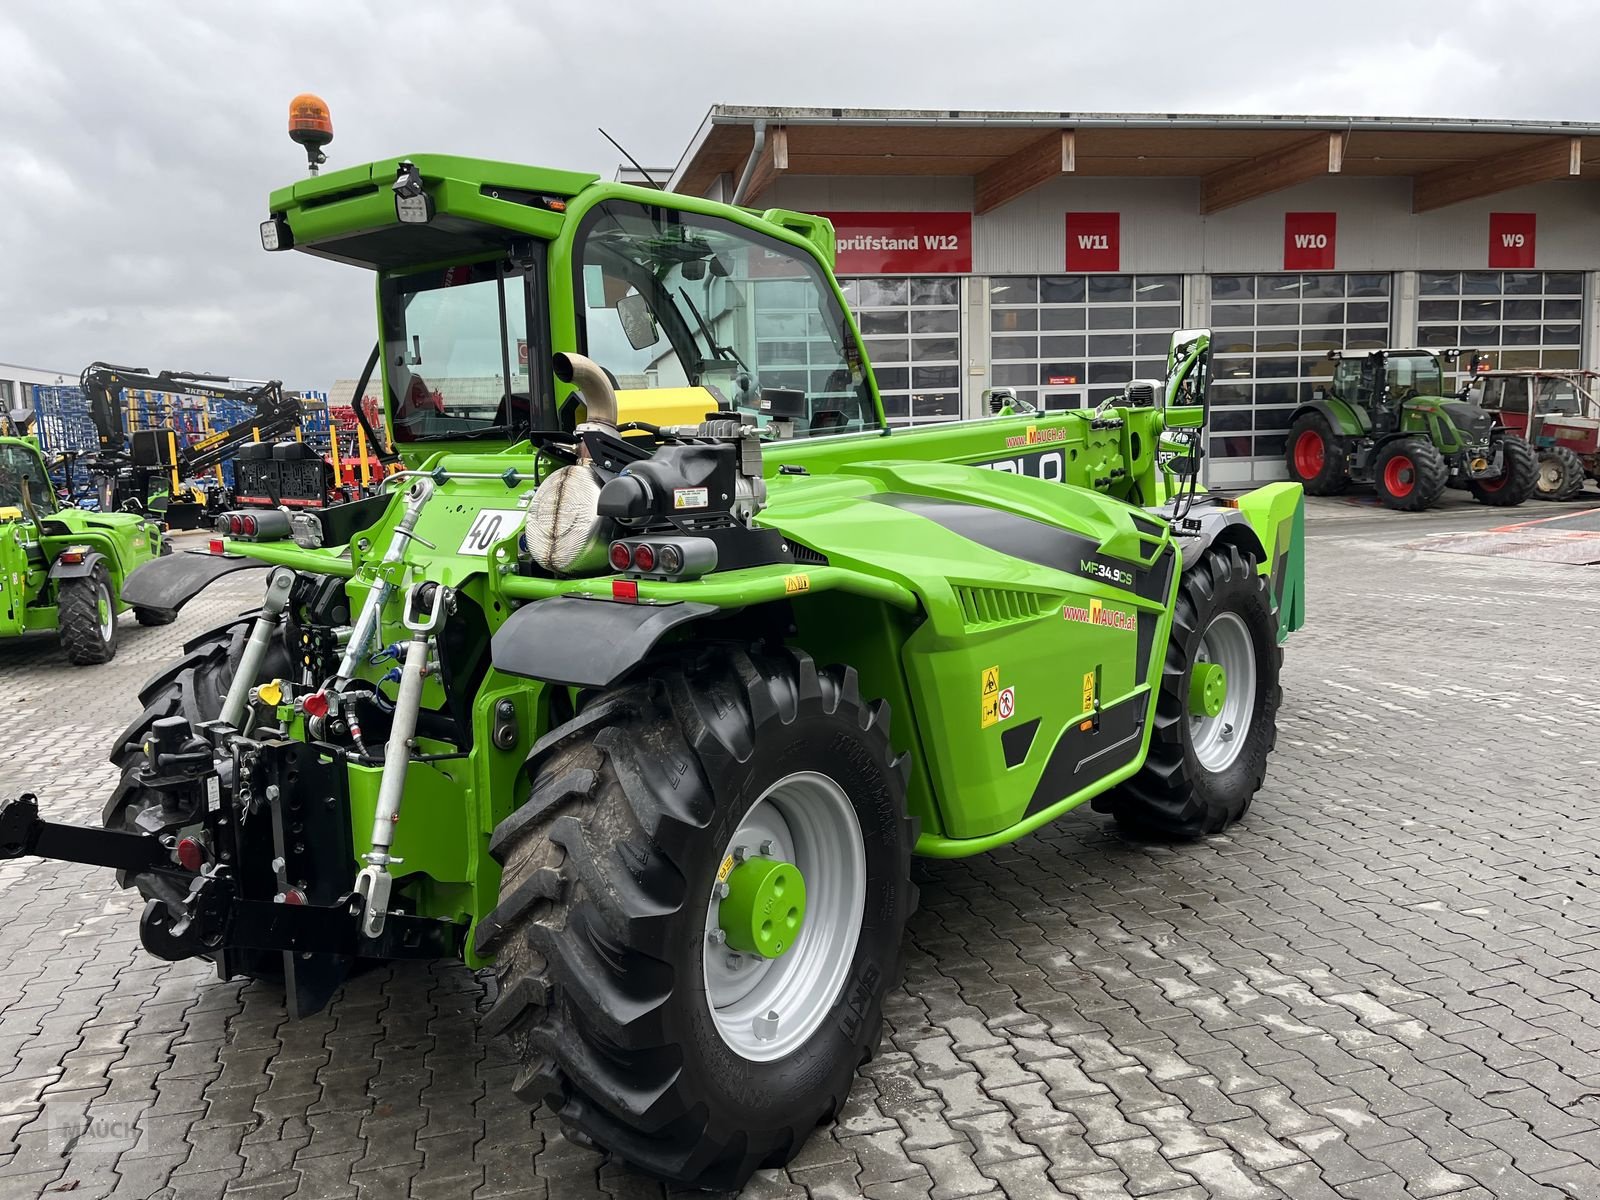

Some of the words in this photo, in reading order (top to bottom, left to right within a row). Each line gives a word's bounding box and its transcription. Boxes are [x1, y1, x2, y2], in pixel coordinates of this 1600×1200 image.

[835, 235, 919, 253] prüfstand
[923, 235, 958, 250] W12
[1078, 235, 1109, 250] W11
[1294, 234, 1327, 249] W10
[1502, 233, 1525, 248] W9
[468, 514, 503, 550] 40
[839, 960, 881, 1044] BKT
